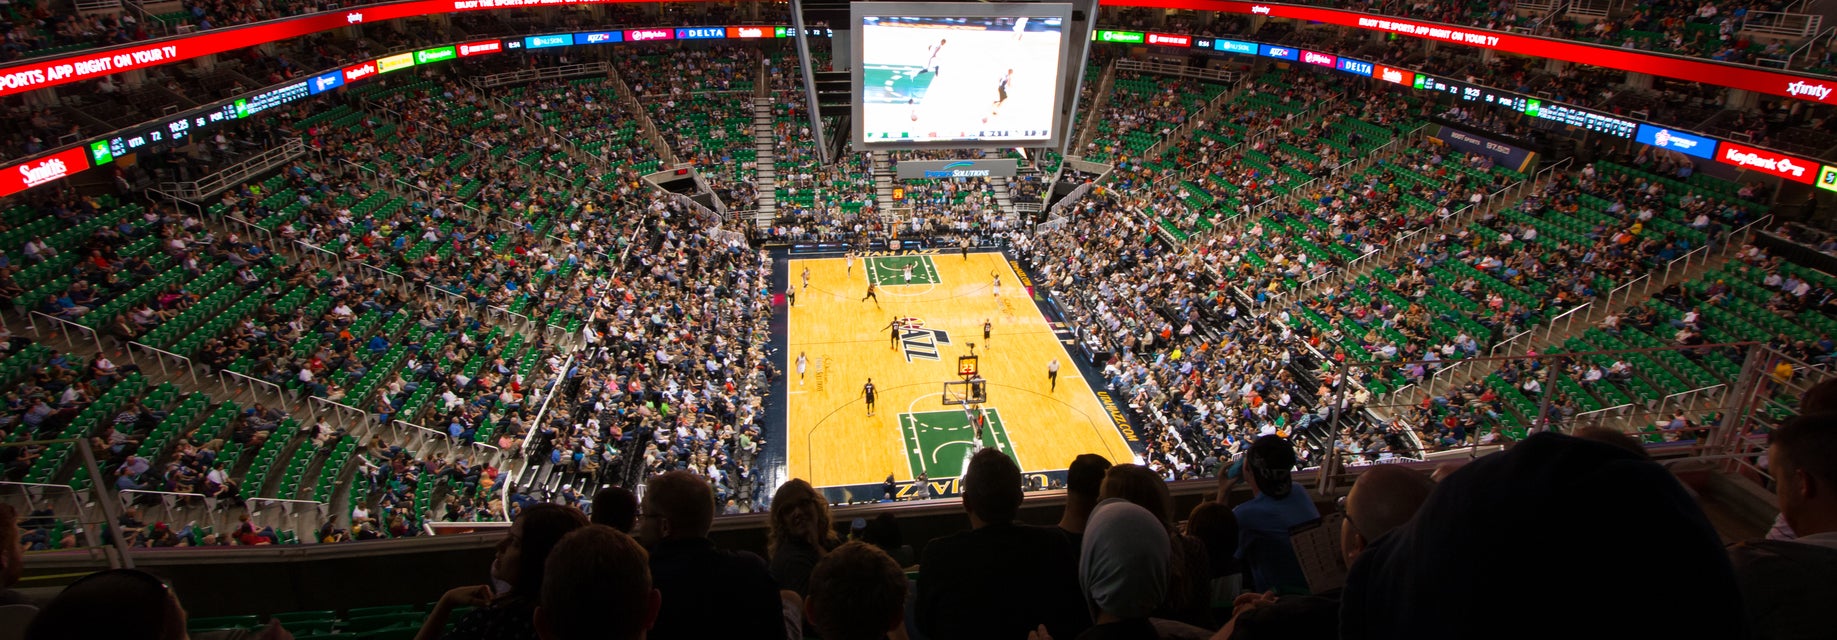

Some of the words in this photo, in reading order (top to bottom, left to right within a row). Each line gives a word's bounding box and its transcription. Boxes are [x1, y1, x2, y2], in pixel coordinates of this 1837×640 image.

[688, 29, 724, 37] DELTA
[1359, 17, 1379, 28] ENJOY
[1378, 20, 1391, 30] THE
[1390, 21, 1415, 34] SPORTS
[1415, 26, 1430, 35] APP
[1429, 27, 1452, 39] RIGHT
[1451, 31, 1464, 41] ON
[1464, 33, 1487, 45] YOUR
[1487, 36, 1499, 46] TV
[47, 64, 73, 81] APP
[74, 57, 112, 76] RIGHT
[113, 53, 132, 68] ON
[131, 48, 163, 65] YOUR
[162, 45, 177, 58] TV
[1345, 61, 1371, 75] DELTA
[1449, 85, 1458, 94] 72
[1786, 80, 1832, 100] xfinity
[196, 117, 206, 127] 56
[209, 111, 224, 123] POR
[168, 118, 190, 133] 10:25
[150, 130, 162, 142] 72
[127, 136, 146, 149] UTA
[1726, 148, 1778, 171] KeyBank
[901, 248, 941, 257] JAZZ
[962, 364, 974, 373] 23
